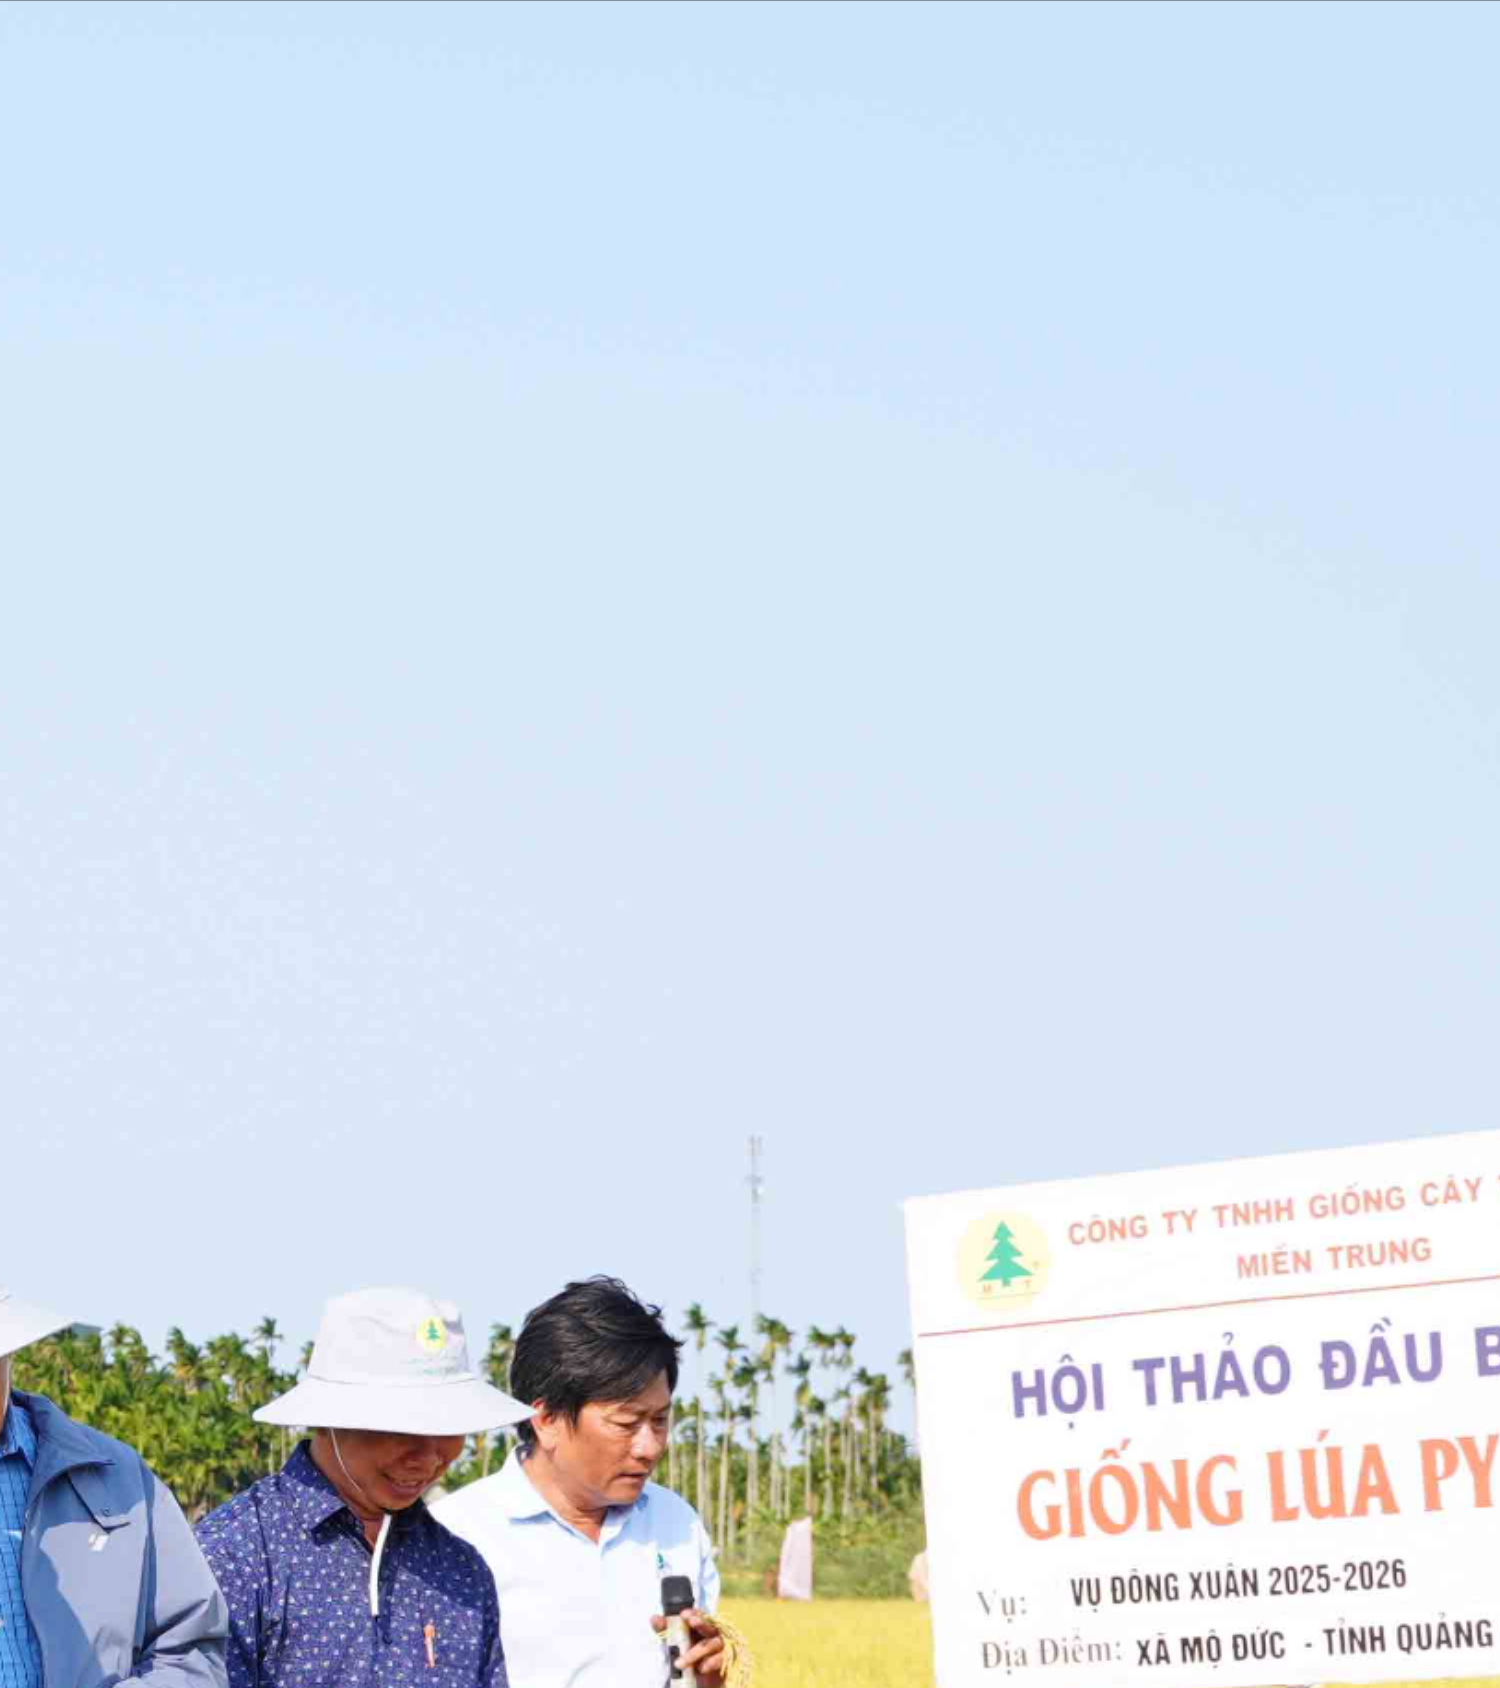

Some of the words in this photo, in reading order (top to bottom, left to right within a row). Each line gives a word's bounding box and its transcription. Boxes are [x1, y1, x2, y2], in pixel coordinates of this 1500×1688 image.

[1068, 1214, 1148, 1246] CÔNG
[1161, 1209, 1197, 1234] TY
[1212, 1197, 1294, 1228] TNHH
[1308, 1183, 1405, 1219] GIỐNG
[1420, 1176, 1481, 1206] CÂY
[1326, 1237, 1431, 1269] TRUNG
[1011, 1354, 1105, 1429] HỘI
[1132, 1332, 1291, 1406] THẢO
[1318, 1317, 1443, 1390] ĐẦU
[1016, 1438, 1244, 1541] GIỐNG
[1266, 1429, 1400, 1523] LÚA
[1418, 1433, 1500, 1512] PY
[1070, 1577, 1102, 1613] VỤ
[1110, 1568, 1180, 1604] ĐÔNG
[1189, 1563, 1259, 1600] XUÂN
[1268, 1558, 1406, 1596] 2025-2026
[982, 1641, 1028, 1675] Địa
[1136, 1633, 1171, 1666] XÃ
[1179, 1629, 1222, 1668] MỘ
[1232, 1627, 1286, 1661] ĐỨC
[1322, 1618, 1386, 1656] TỈNH
[1396, 1612, 1493, 1655] QUẢNG
